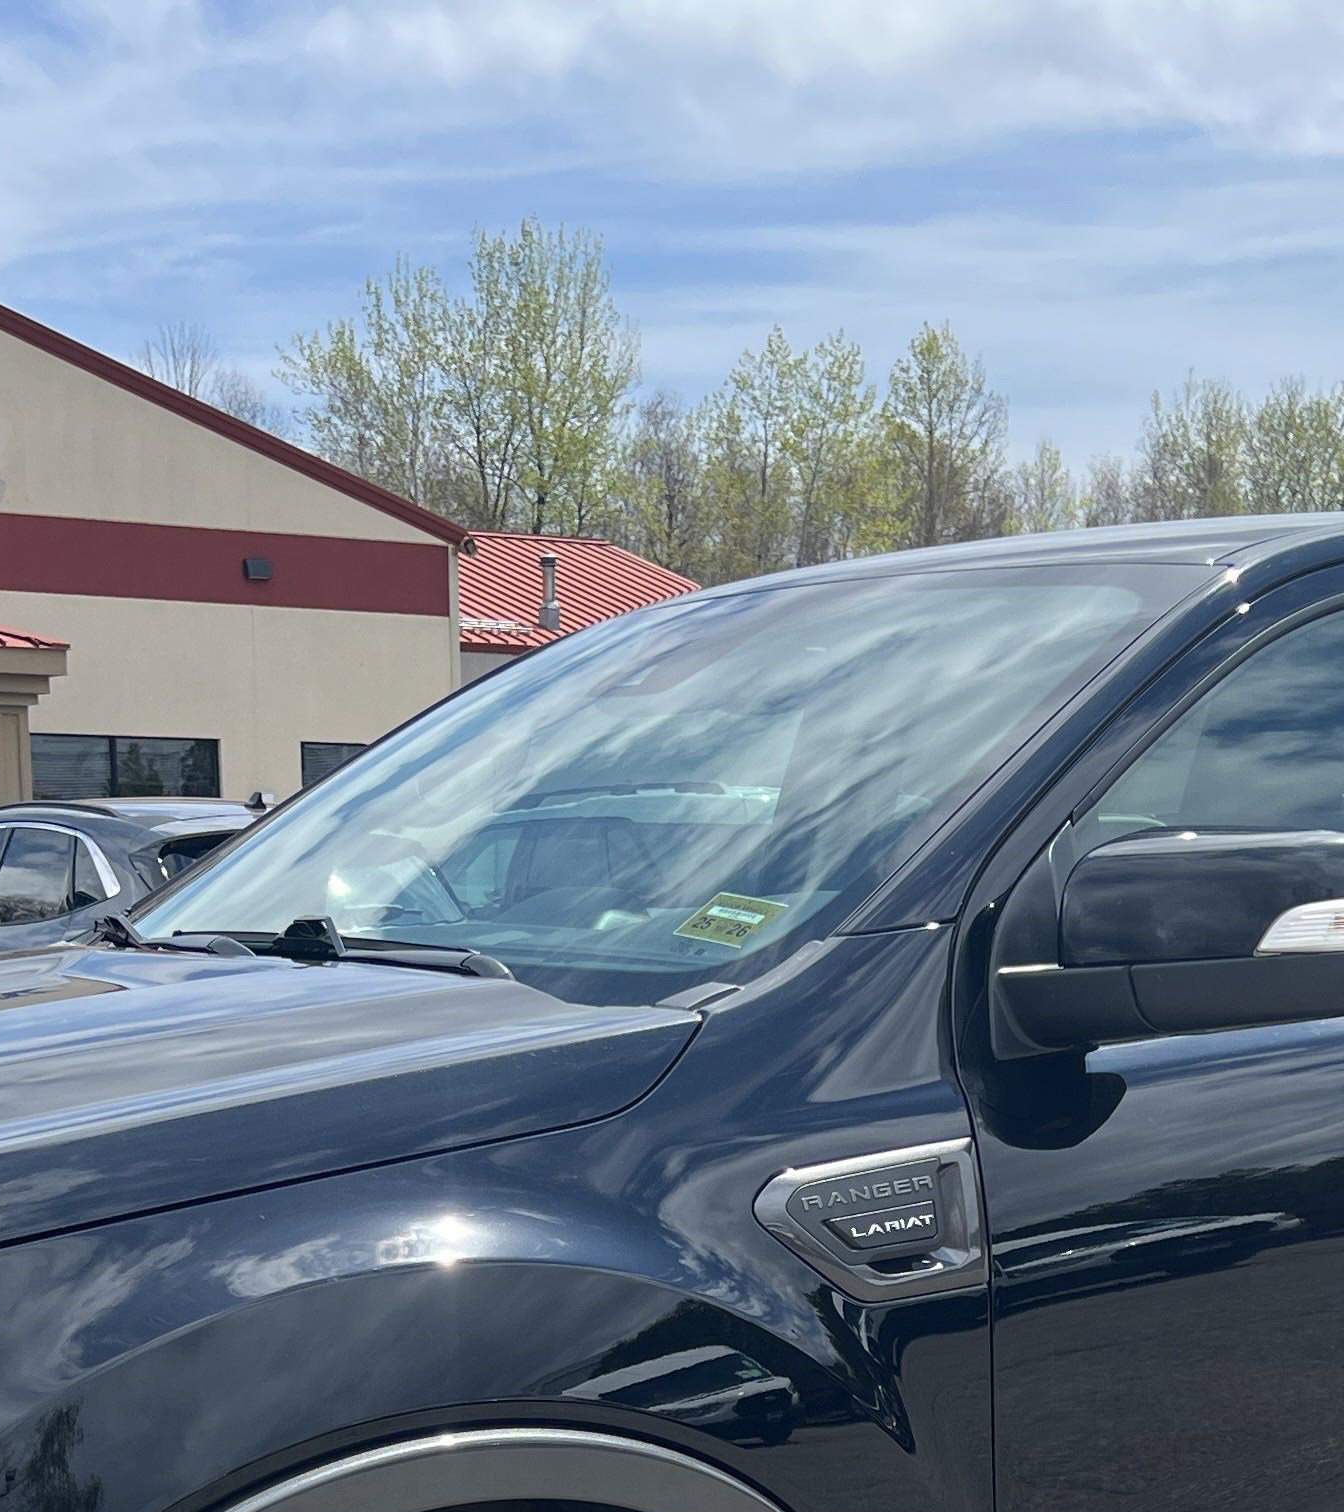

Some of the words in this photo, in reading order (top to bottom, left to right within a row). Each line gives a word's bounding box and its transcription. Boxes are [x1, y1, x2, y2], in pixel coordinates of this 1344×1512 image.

[691, 916, 717, 930] 25
[725, 923, 752, 937] 26
[802, 1175, 934, 1211] RANGER
[851, 1214, 934, 1238] LARIAT
